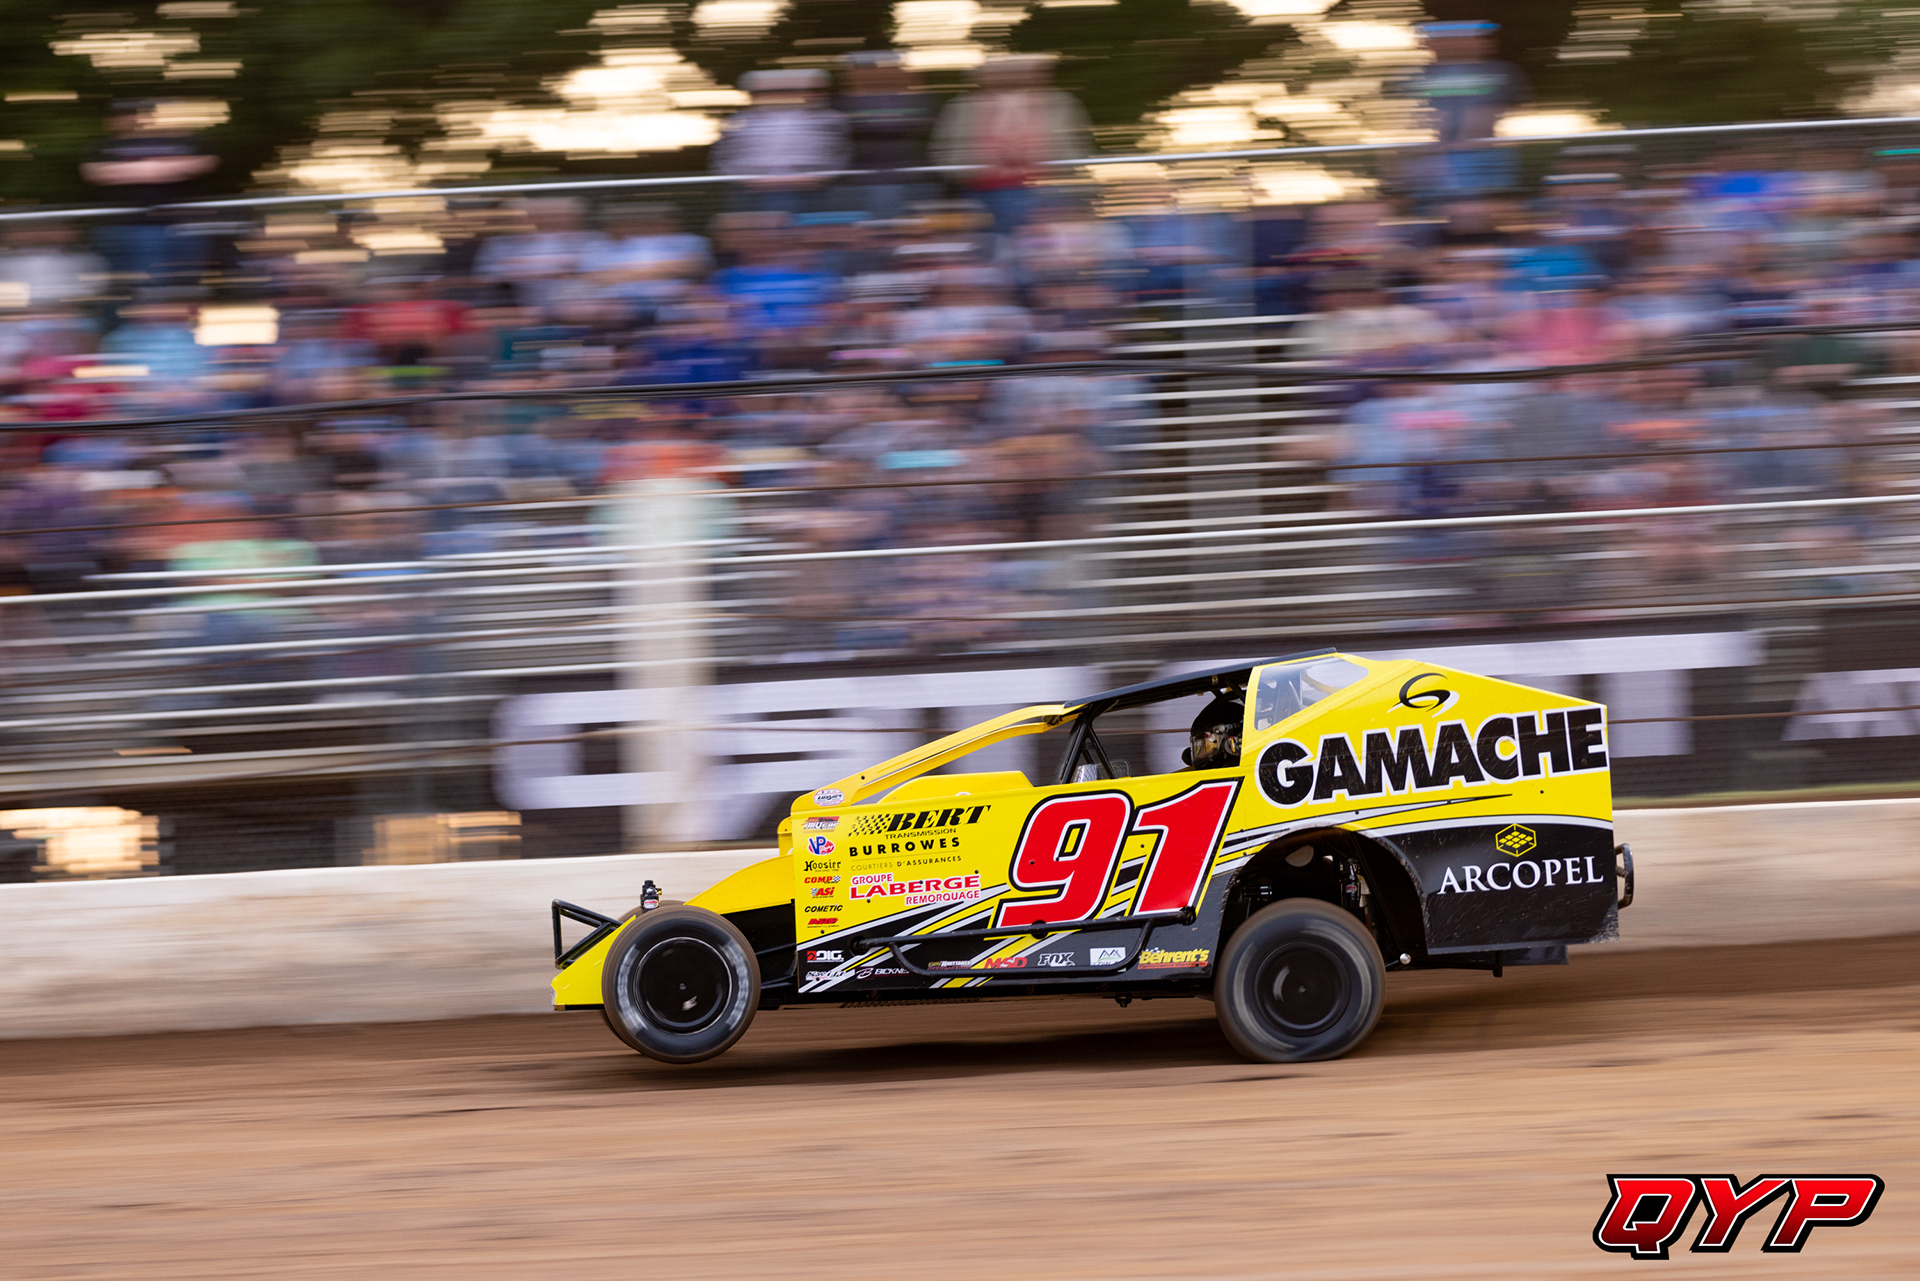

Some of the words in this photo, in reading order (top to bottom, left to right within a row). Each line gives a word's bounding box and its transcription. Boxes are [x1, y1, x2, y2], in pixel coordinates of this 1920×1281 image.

[1259, 707, 1608, 806] GAMACHE
[885, 805, 992, 832] BERT
[884, 828, 957, 840] TRANSMISSION
[849, 837, 960, 857] BURROWES
[998, 778, 1238, 928] 91
[803, 859, 842, 872] Hoosier
[851, 862, 893, 872] COURTIERS
[896, 855, 962, 868] D'ASSURANCES
[804, 876, 833, 884] COMP
[852, 873, 893, 885] GROUPE
[1437, 856, 1604, 895] ARCOPEL
[850, 875, 980, 899] LABERGE
[905, 889, 980, 905] REMORQUAGE
[804, 904, 843, 913] COMETIC
[984, 956, 1028, 969] MSD
[1037, 951, 1076, 966] FOX
[1138, 948, 1210, 965] Behrent's
